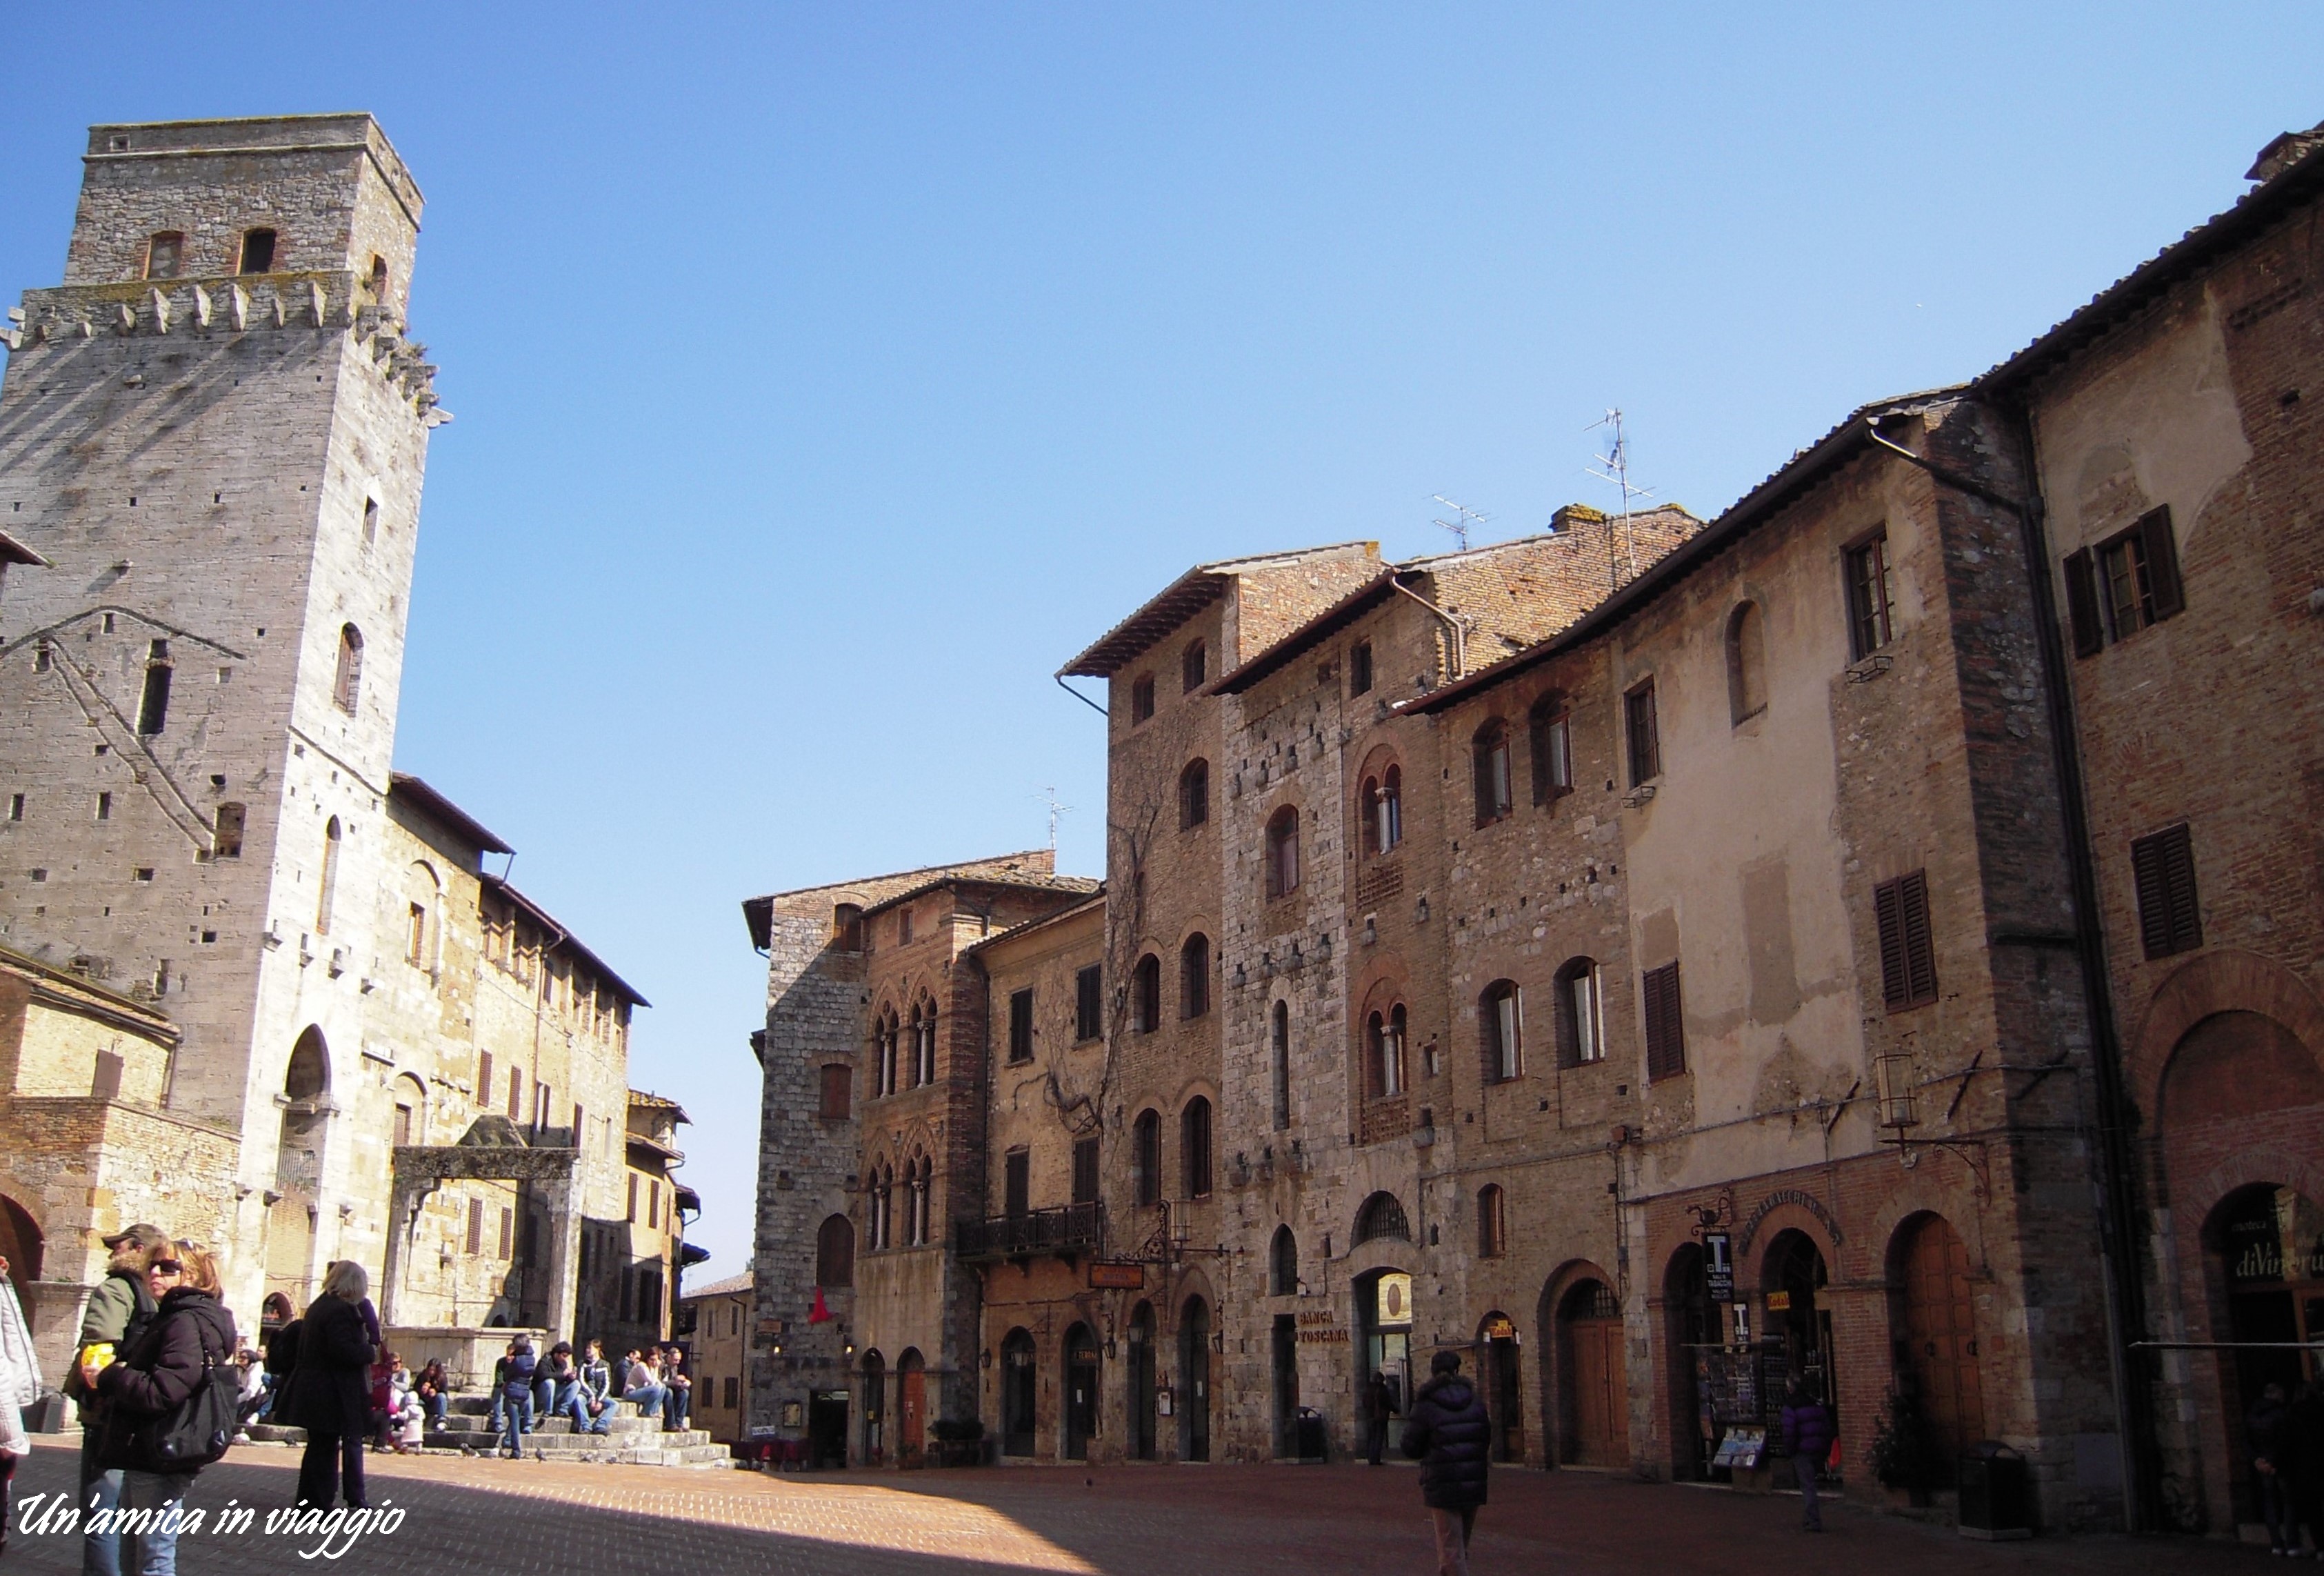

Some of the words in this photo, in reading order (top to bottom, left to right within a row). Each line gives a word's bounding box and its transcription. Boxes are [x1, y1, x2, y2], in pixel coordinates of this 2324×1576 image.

[1707, 1279, 1733, 1288] TABACCHI
[1767, 1294, 1788, 1306] Kodak
[1300, 1311, 1333, 1324] BANCA
[1299, 1330, 1349, 1343] TOSCANA
[1490, 1326, 1512, 1337] Kodak
